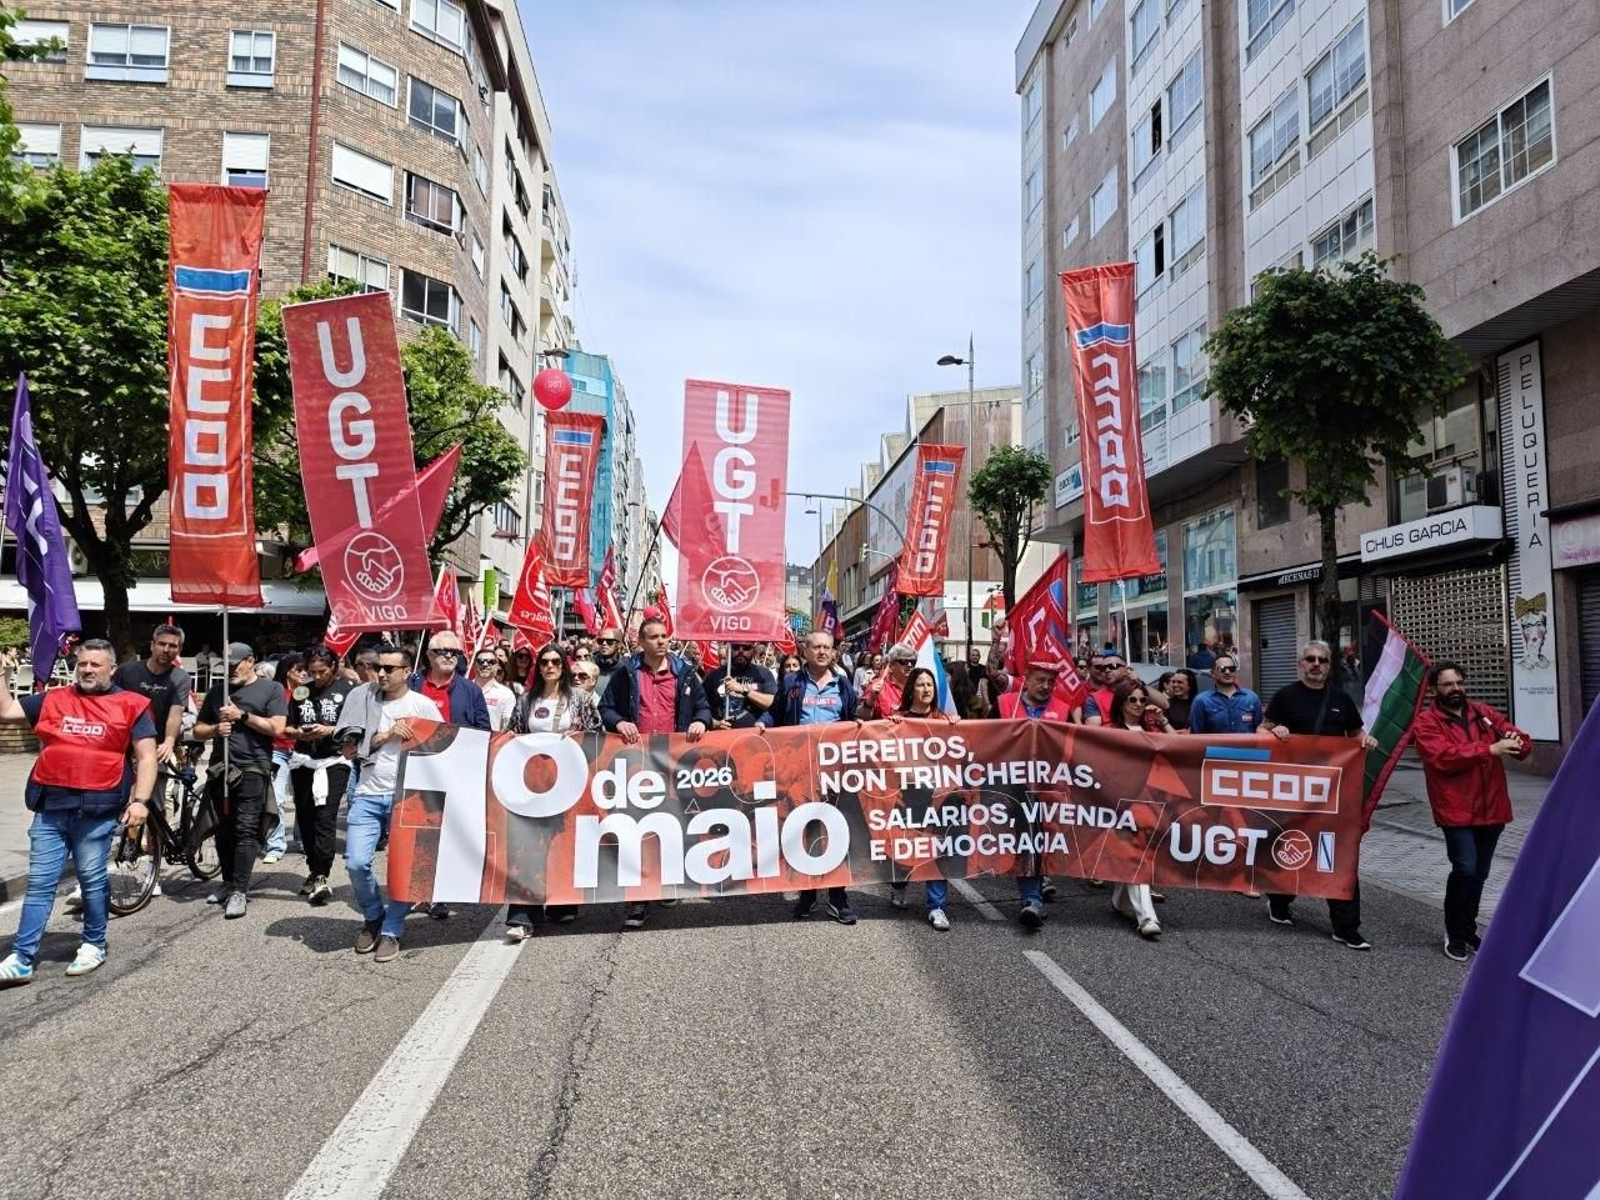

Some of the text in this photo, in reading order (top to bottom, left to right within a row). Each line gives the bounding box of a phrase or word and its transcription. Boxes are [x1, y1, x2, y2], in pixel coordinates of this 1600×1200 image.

[184, 313, 232, 519] CCOO
[316, 316, 379, 529] UGT
[713, 389, 759, 554] UGT
[1519, 354, 1543, 549] PELUQUERIA
[554, 453, 582, 561] CCOO
[915, 480, 945, 574] CCOO
[1365, 518, 1467, 553] CHUS GARCIA
[363, 604, 408, 621] VIGO
[709, 615, 751, 631] VIGO
[61, 724, 103, 736] CCOO
[818, 735, 974, 766] DEREITOS,
[590, 758, 665, 809] de
[676, 767, 733, 789] 2026
[819, 760, 1102, 796] NON TRINCHEIRAS.
[1211, 768, 1331, 803] CCOO
[573, 780, 850, 888] maio
[868, 801, 1137, 832] SALARIOS, VIVENDA
[870, 832, 1070, 861] E DEMOCRACIA
[1169, 821, 1268, 866] UGT
